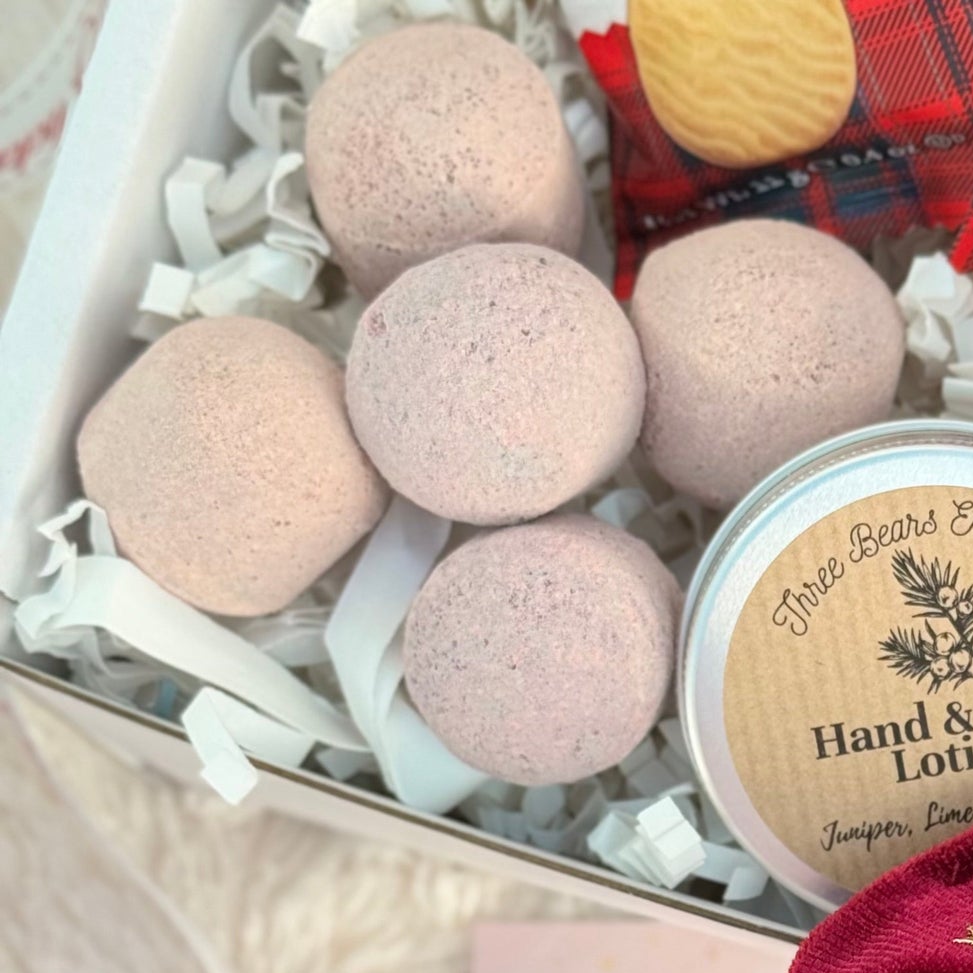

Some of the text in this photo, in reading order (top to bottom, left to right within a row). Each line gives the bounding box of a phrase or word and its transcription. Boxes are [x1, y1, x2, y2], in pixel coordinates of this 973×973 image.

[772, 556, 844, 636] Three
[848, 509, 937, 564] Bears
[811, 700, 933, 760] Hand
[820, 820, 914, 852] Juniper,
